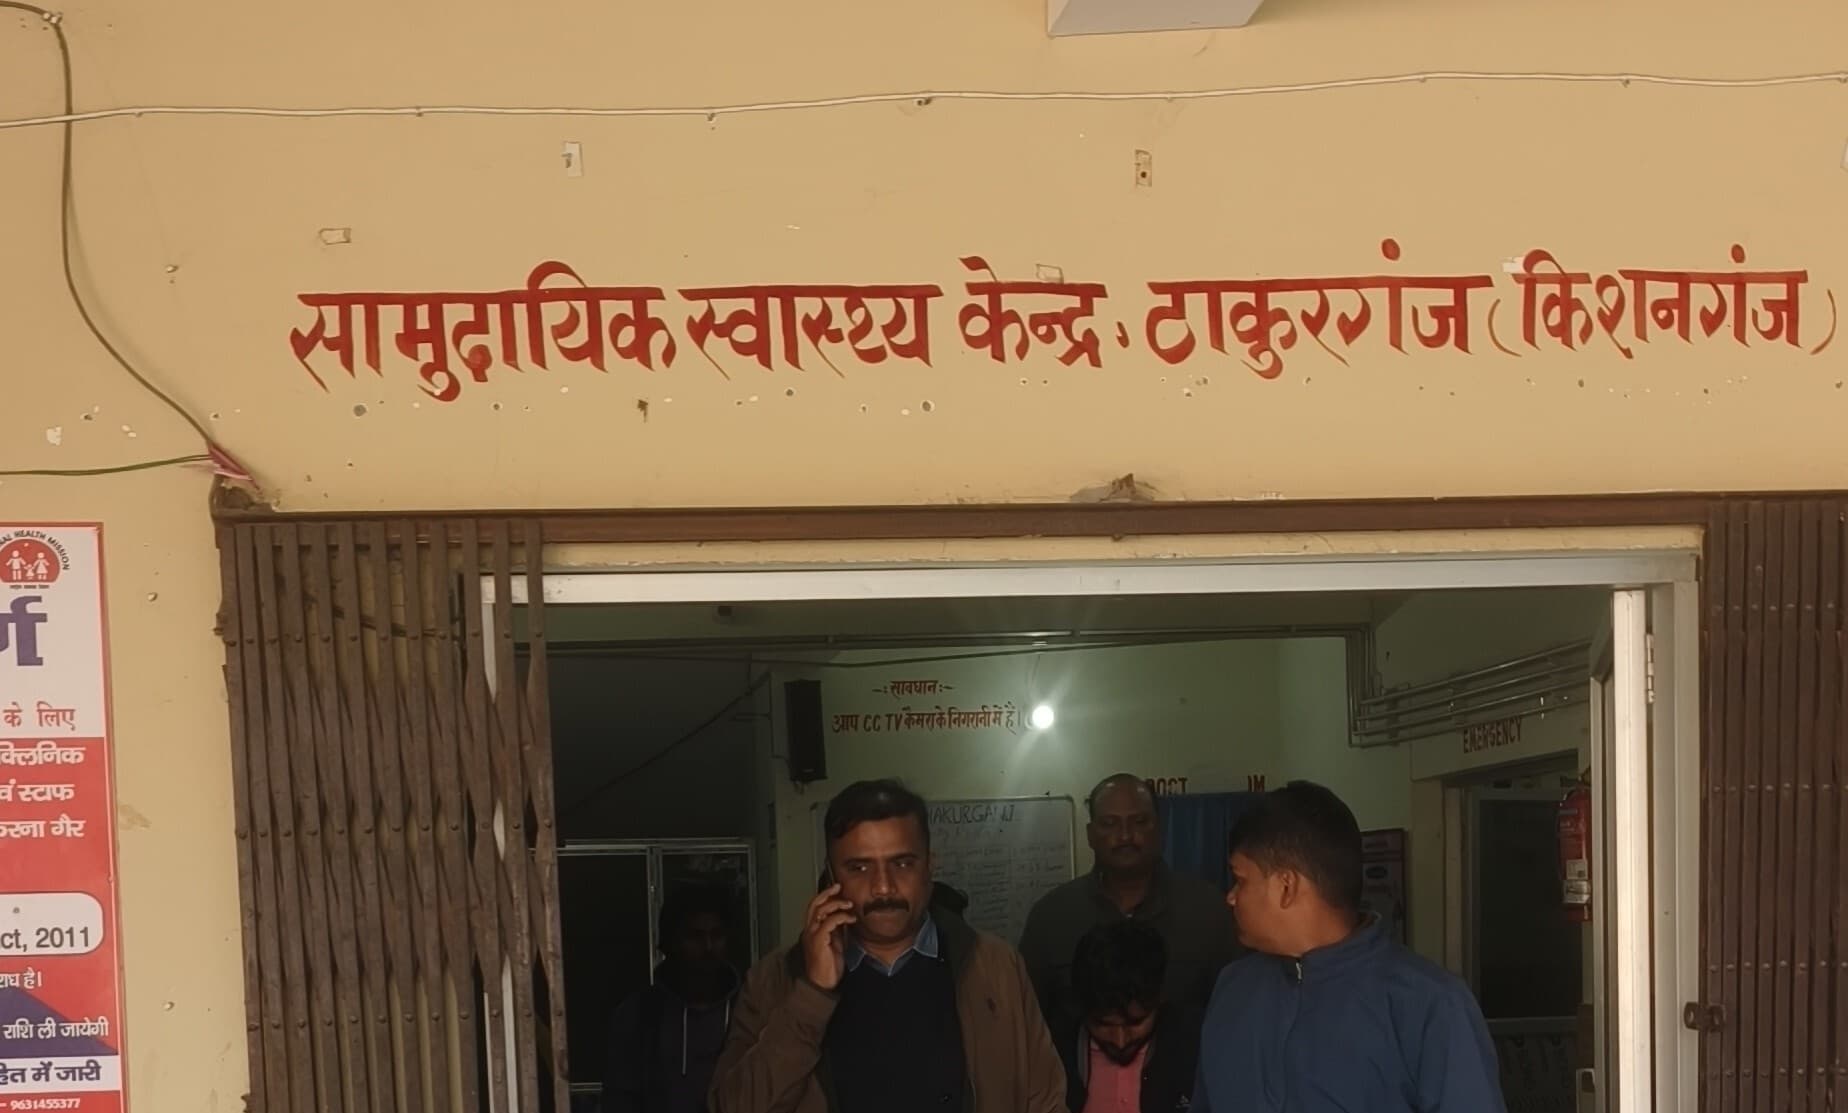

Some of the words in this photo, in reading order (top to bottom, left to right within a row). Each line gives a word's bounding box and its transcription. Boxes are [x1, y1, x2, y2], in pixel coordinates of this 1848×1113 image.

[290, 260, 676, 402] सामुदायिक
[678, 283, 943, 379] स्वास्थ्य
[1146, 237, 1494, 380] ठाकुरगंज
[14, 529, 47, 540] HEALTH
[47, 537, 71, 570] MISSION
[3, 701, 23, 728] के
[36, 700, 76, 732] लिए
[831, 714, 860, 734] आप
[1463, 716, 1522, 753] EMERGENCY
[17, 783, 76, 802] स्टाफ
[49, 813, 87, 837] गैर
[35, 926, 90, 949] 2011
[3, 1017, 34, 1040] राशि
[37, 1016, 57, 1040] ली
[59, 1015, 110, 1038] जायेगी
[30, 1060, 53, 1083] में
[54, 1058, 102, 1082] जारी
